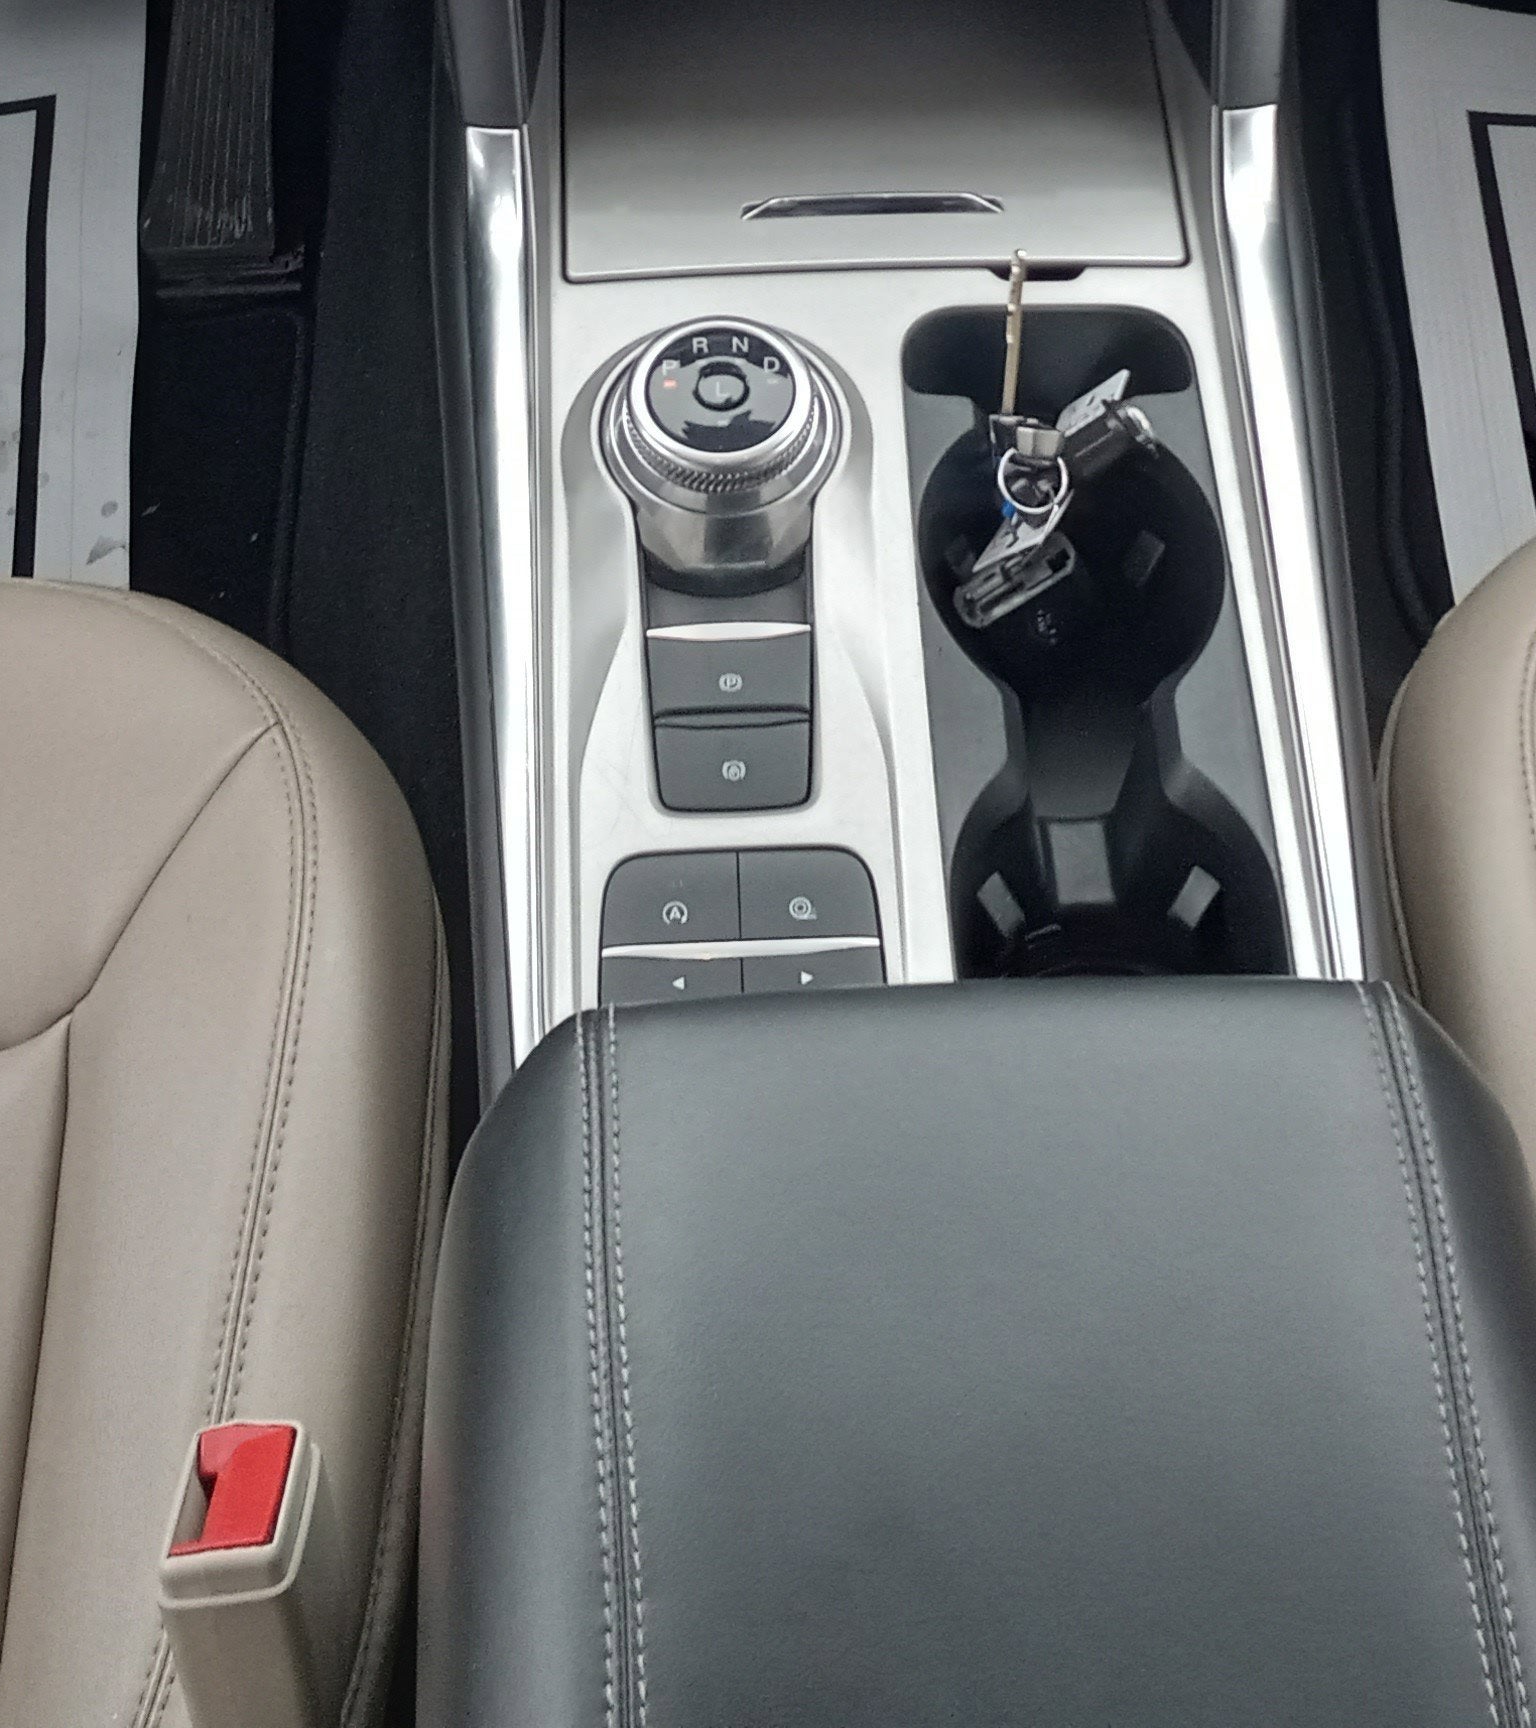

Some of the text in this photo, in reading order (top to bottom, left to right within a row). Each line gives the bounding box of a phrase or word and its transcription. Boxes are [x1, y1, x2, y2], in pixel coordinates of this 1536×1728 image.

[692, 337, 709, 354] R
[732, 336, 749, 353] N
[763, 356, 780, 373] D
[716, 382, 729, 397] L
